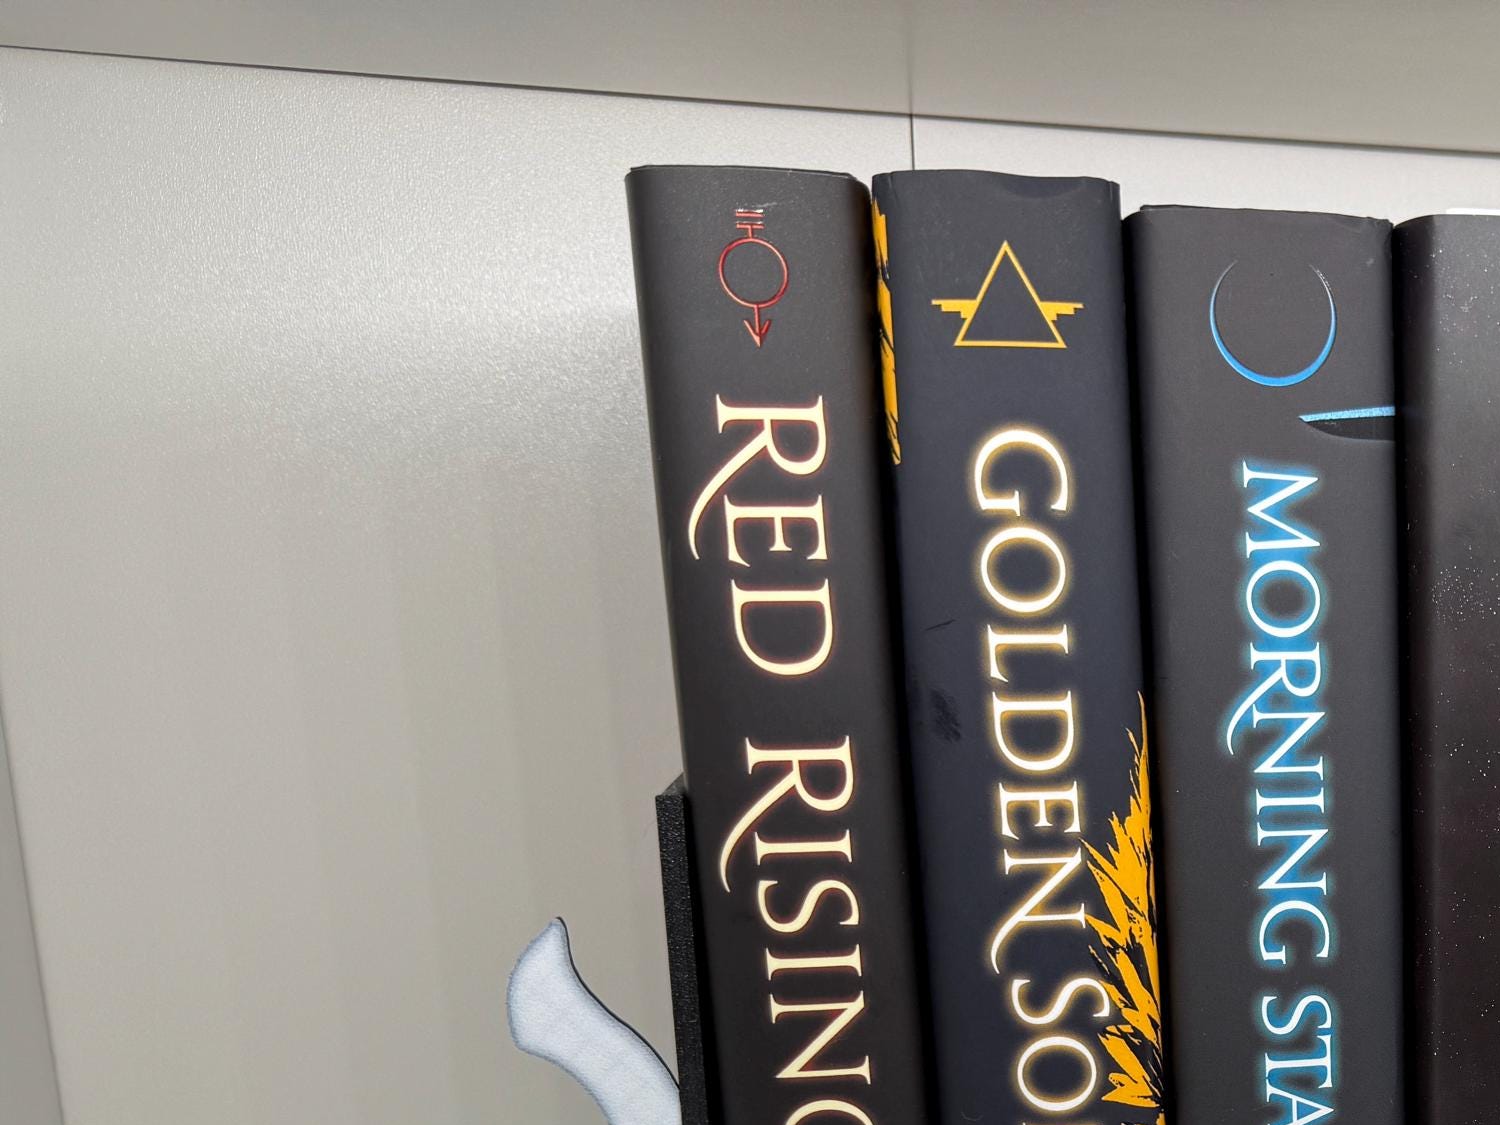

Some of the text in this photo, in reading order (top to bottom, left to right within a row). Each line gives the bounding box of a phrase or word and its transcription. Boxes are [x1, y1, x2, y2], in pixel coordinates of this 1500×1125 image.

[688, 394, 834, 676] RED
[973, 428, 1088, 975] GOLDEN
[1226, 460, 1331, 966] MORNING
